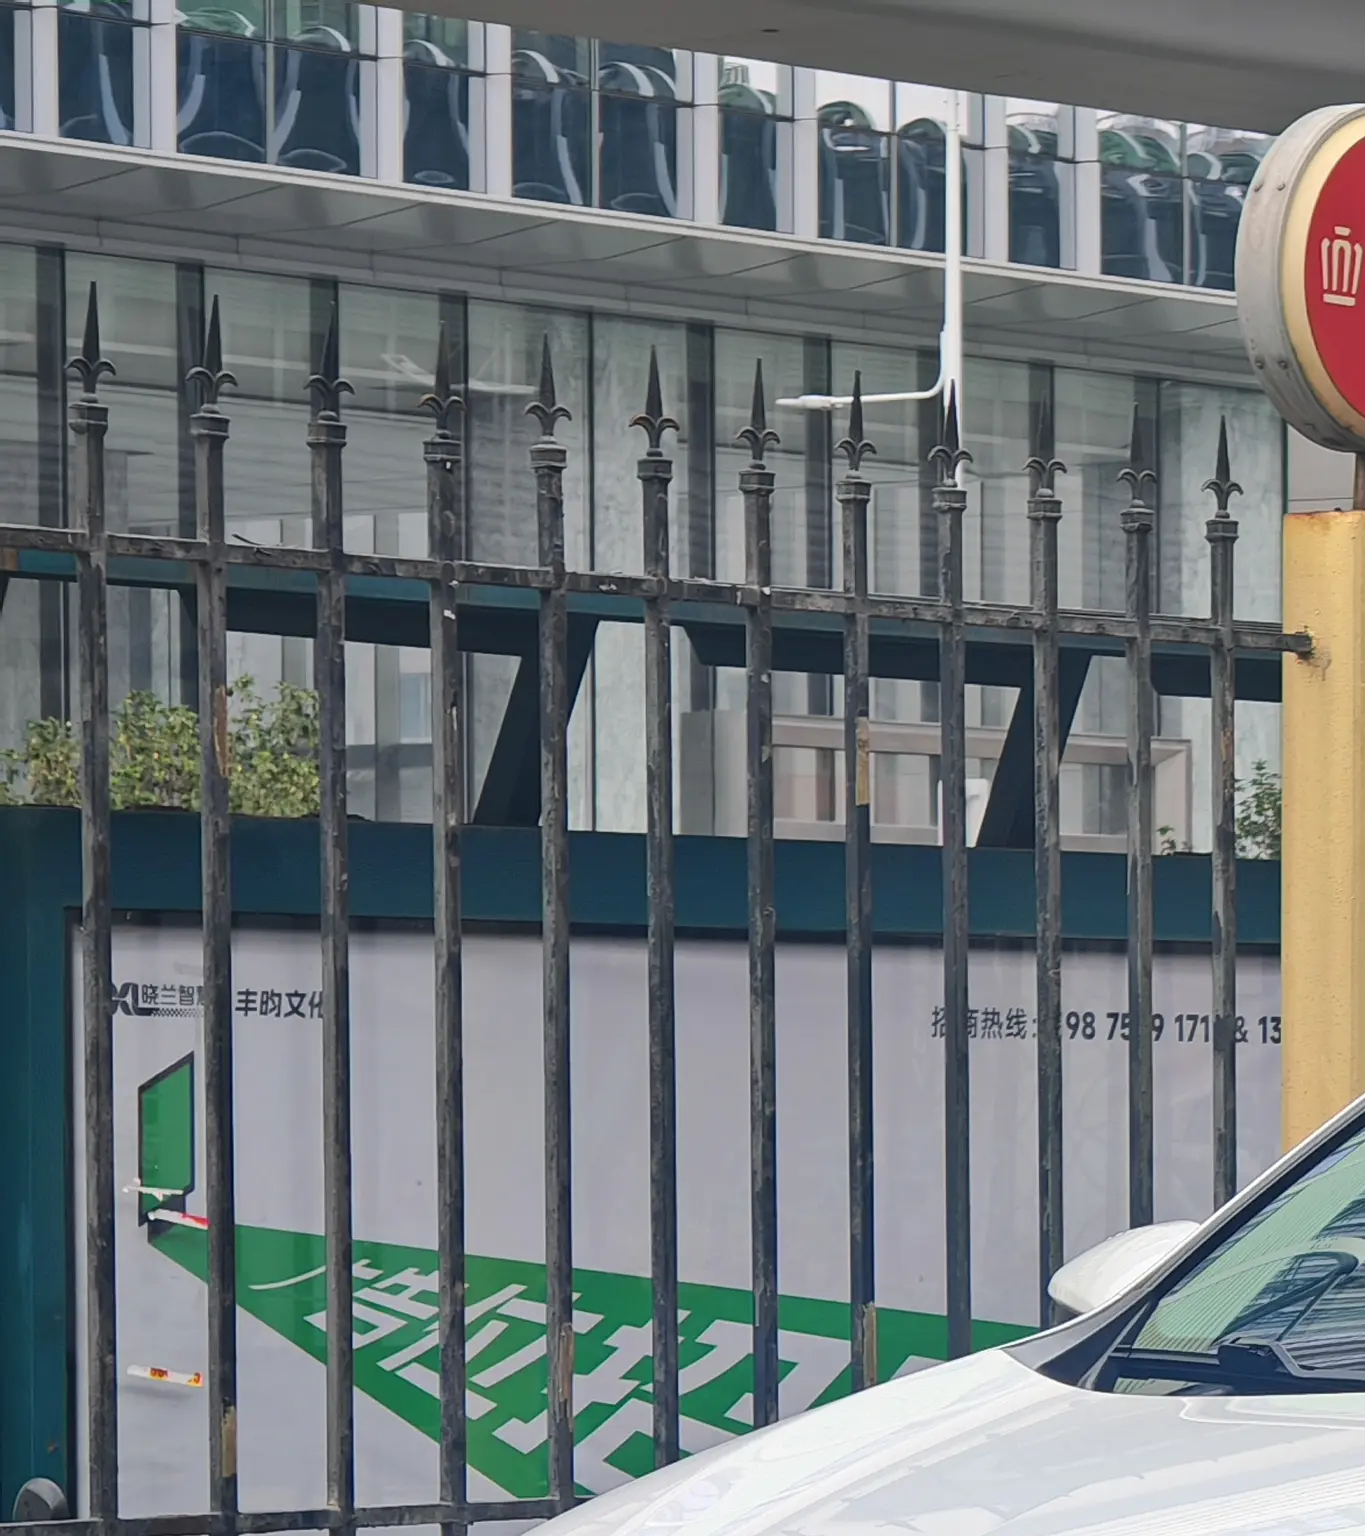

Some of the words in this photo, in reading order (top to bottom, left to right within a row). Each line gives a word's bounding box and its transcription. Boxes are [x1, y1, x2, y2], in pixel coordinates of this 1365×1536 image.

[141, 983, 205, 1006] 晓兰智
[1060, 1011, 1096, 1040] 98
[1105, 1012, 1164, 1041] 759
[1174, 1013, 1213, 1043] 171
